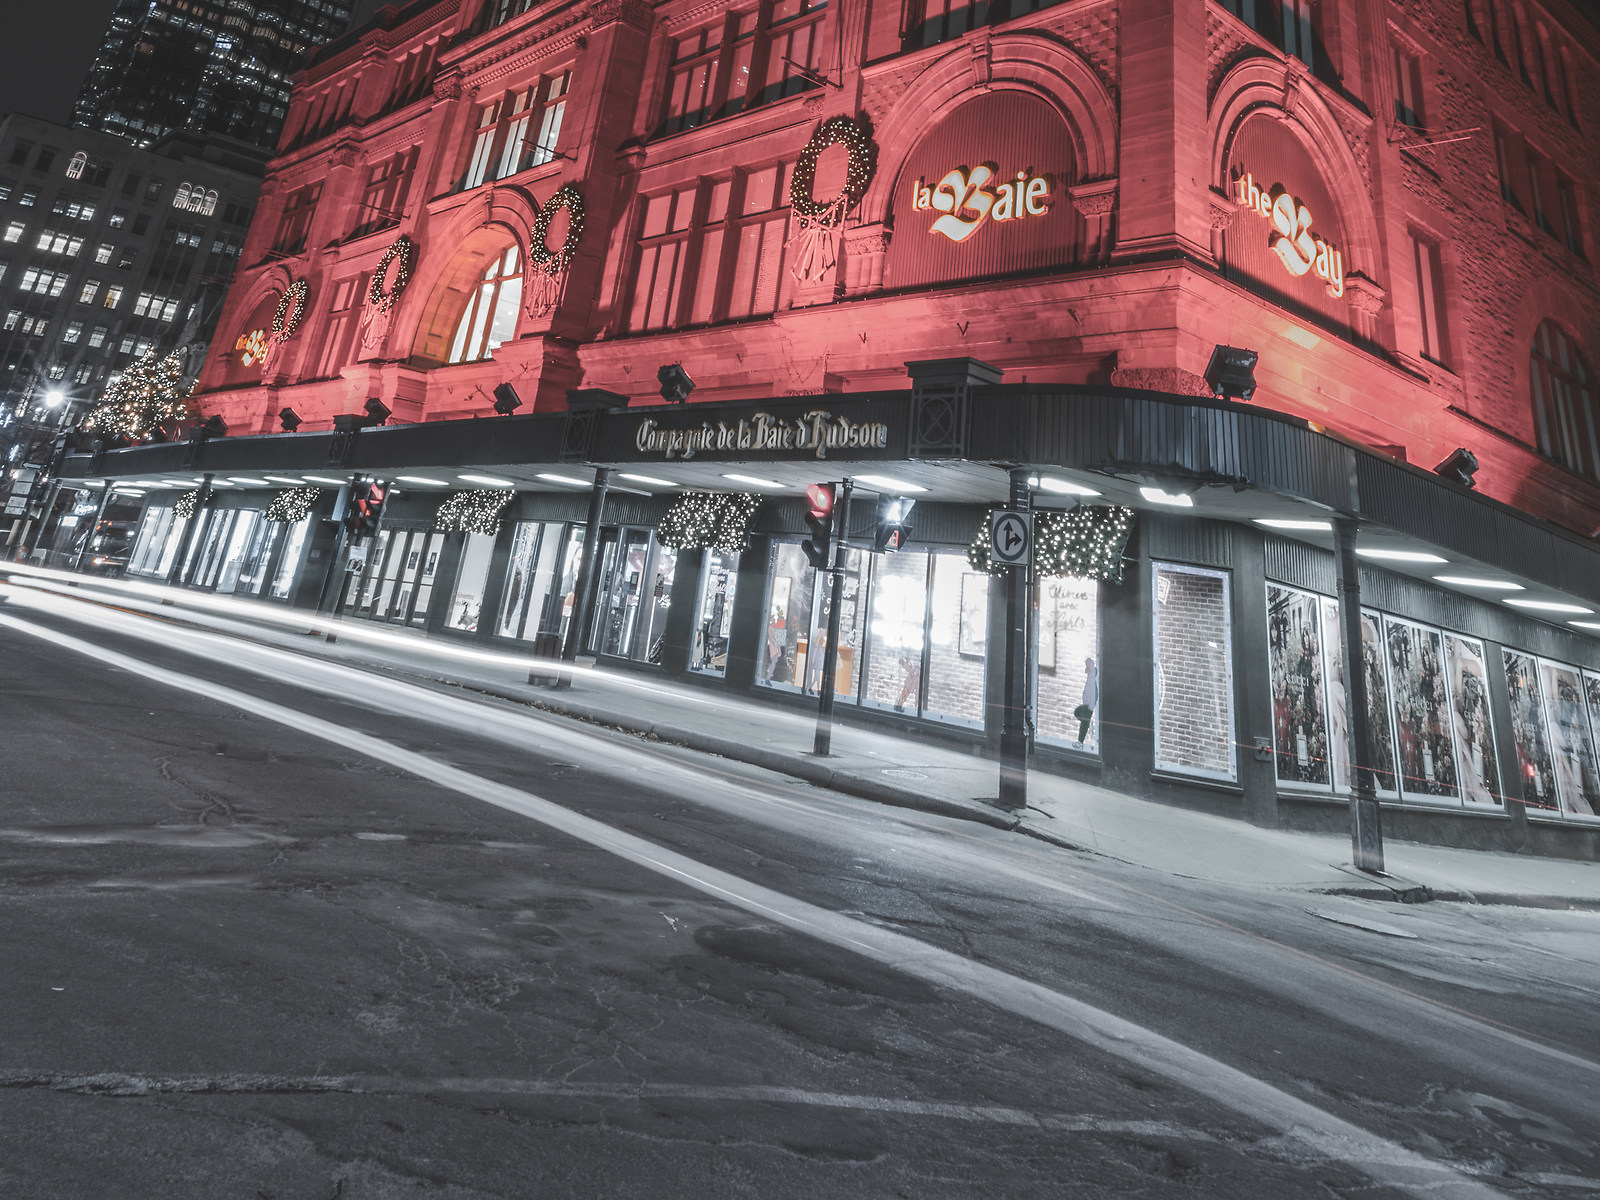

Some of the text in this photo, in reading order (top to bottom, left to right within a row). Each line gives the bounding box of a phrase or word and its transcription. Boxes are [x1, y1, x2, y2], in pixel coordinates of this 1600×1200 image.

[912, 165, 1049, 242] la Baie
[1238, 173, 1343, 297] the Bay
[717, 421, 737, 450] de
[737, 419, 752, 450] la
[751, 412, 793, 450] Baie
